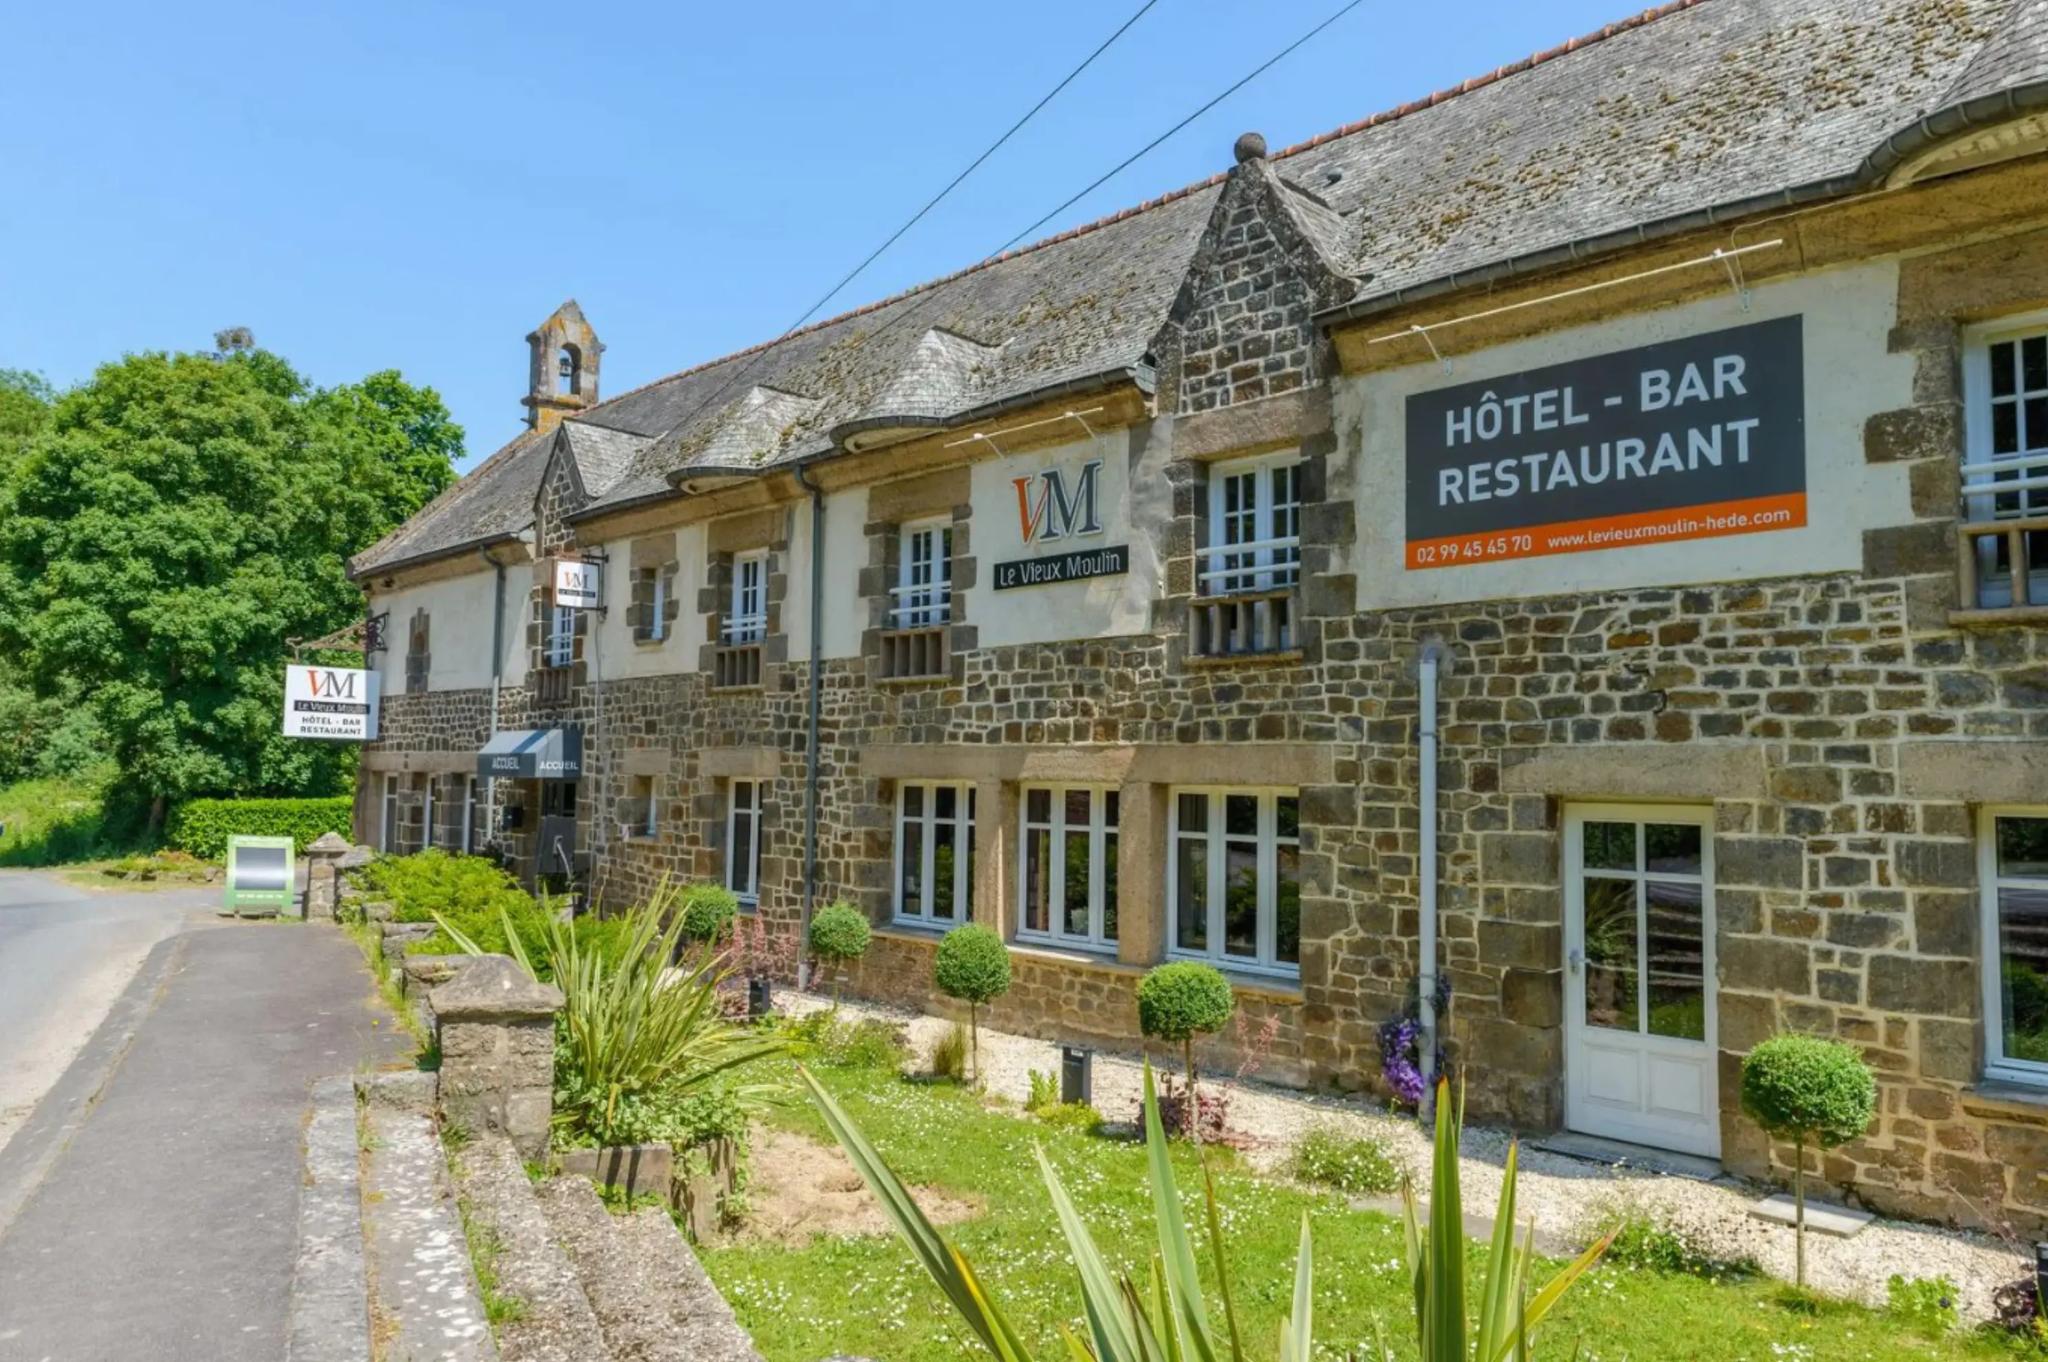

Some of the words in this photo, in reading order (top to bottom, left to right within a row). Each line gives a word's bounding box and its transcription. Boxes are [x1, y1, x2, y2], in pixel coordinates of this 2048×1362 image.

[1446, 386, 1589, 447] HÔTEL
[1641, 354, 1748, 412] BAR
[1438, 418, 1760, 506] RESTAURANT
[1011, 461, 1102, 544] VM
[1417, 546, 1435, 563] 02
[1440, 543, 1459, 560] 99
[1463, 541, 1482, 557] 45
[1487, 538, 1507, 554] 45
[1512, 535, 1532, 551] 70
[1548, 507, 1790, 549] www.levieuxmoulin-hede.com
[1000, 565, 1016, 586] Le
[1020, 561, 1061, 584] Vieux
[1066, 552, 1121, 577] Moulin
[307, 670, 357, 698] VM
[300, 725, 361, 735] RESTAURANT
[302, 716, 332, 725] HÔTEL
[342, 718, 361, 726] BAR
[540, 760, 579, 770] ACCUEIL
